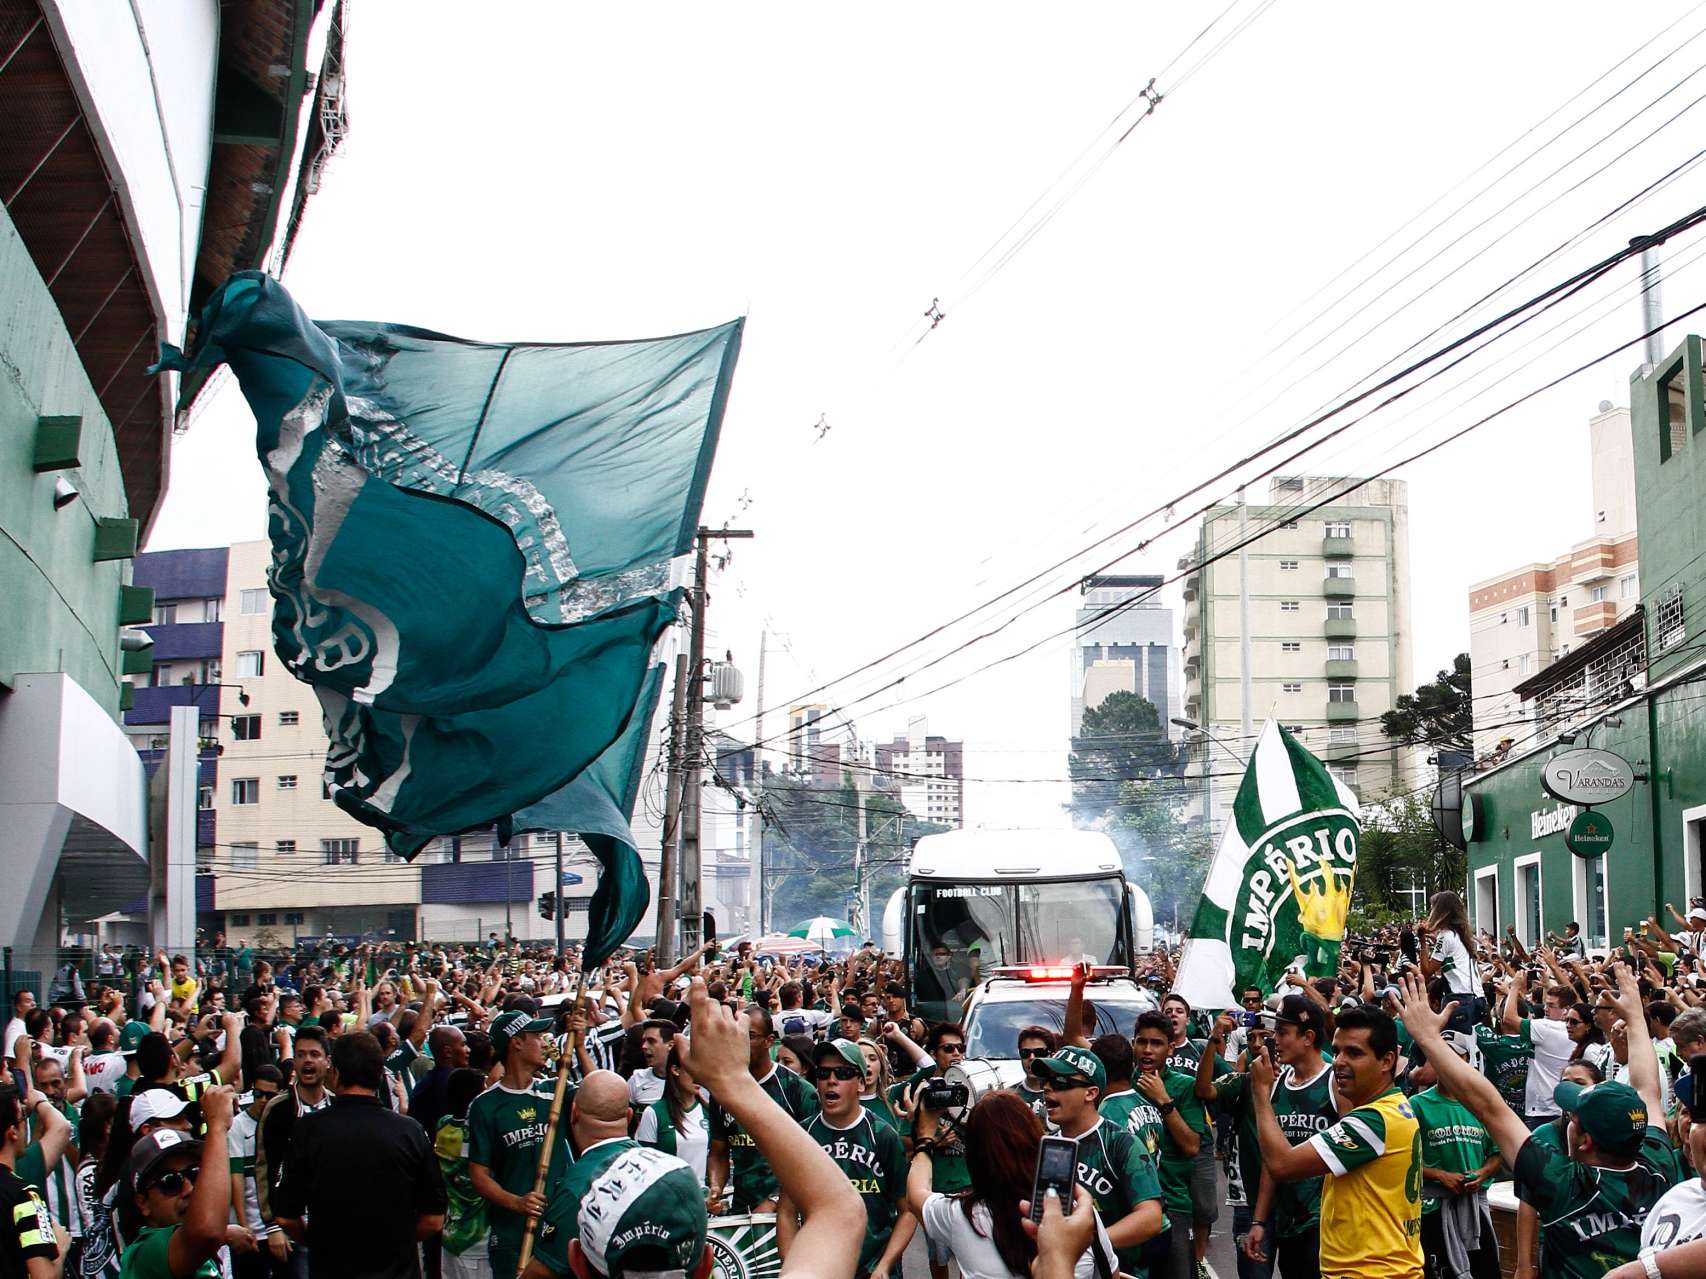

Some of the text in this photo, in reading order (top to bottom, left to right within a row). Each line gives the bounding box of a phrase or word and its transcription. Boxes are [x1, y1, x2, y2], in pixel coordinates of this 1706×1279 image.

[1556, 768, 1626, 791] VARANDA'S
[1531, 803, 1578, 840] Heineken
[1574, 833, 1610, 843] Heineken
[936, 886, 1002, 899] FOOTBALL CLUB
[1241, 827, 1357, 952] IMPÉRIO
[1165, 1054, 1200, 1072] PÉRI
[1279, 1111, 1329, 1133] PÉRIO
[821, 1136, 885, 1178] PÉRIO
[612, 1220, 671, 1250] Império
